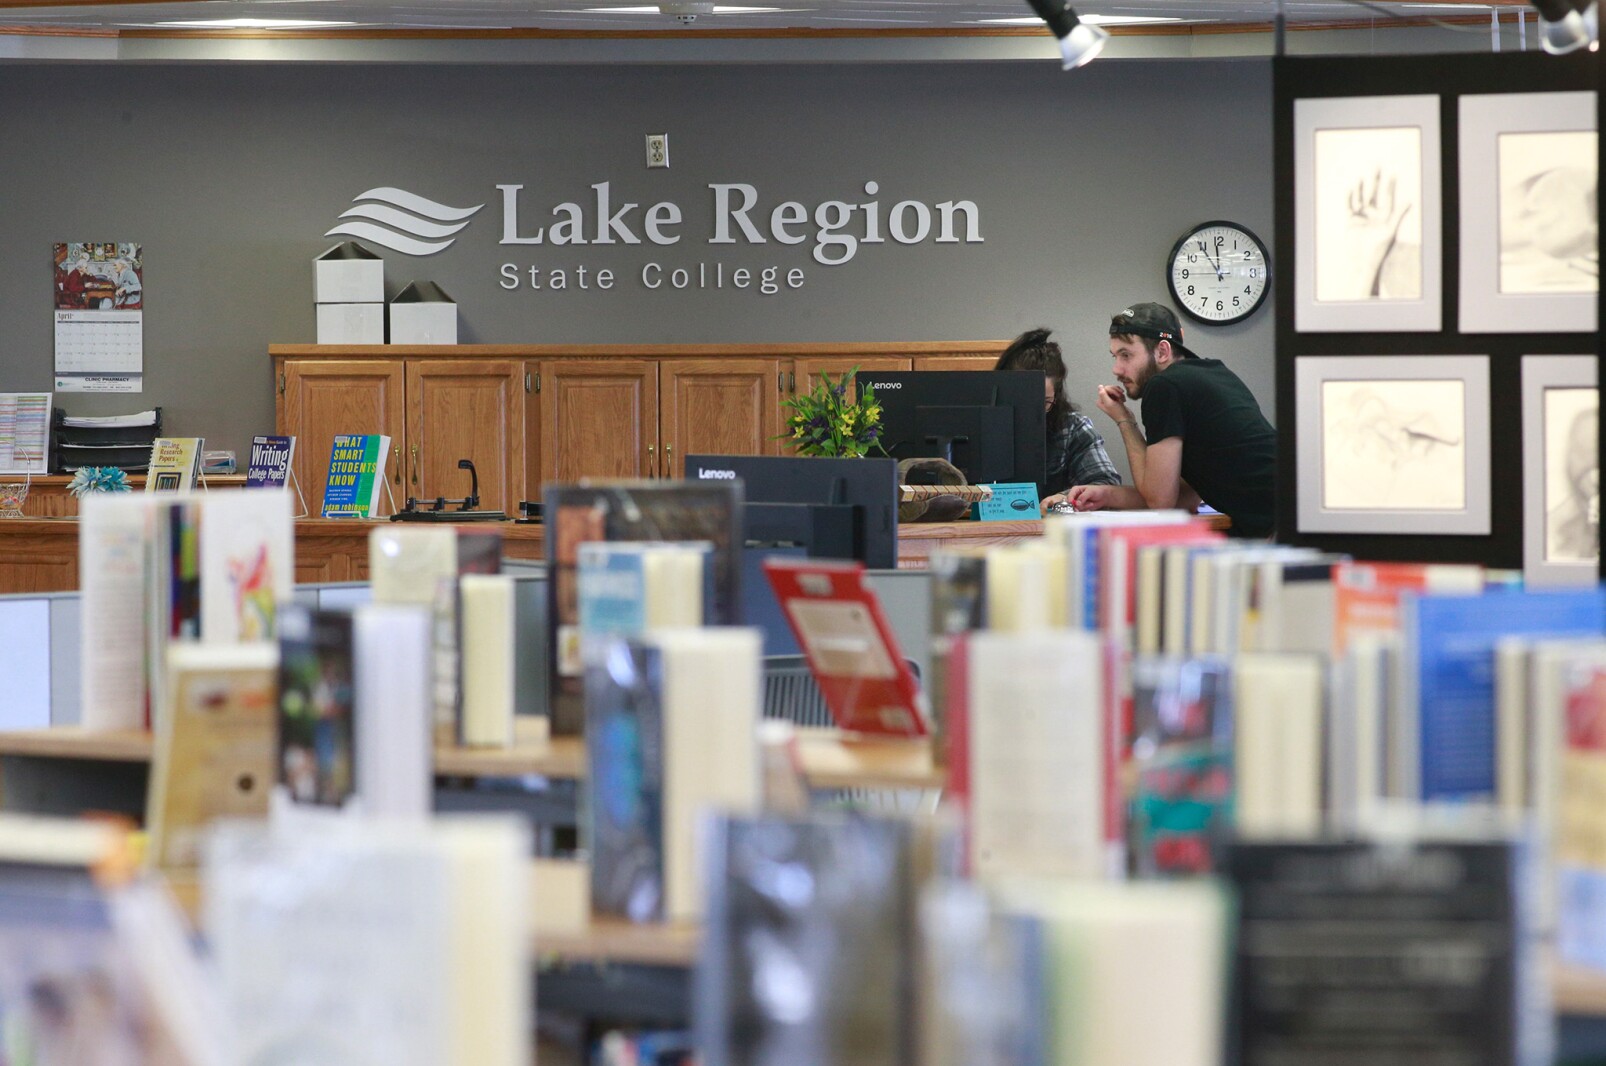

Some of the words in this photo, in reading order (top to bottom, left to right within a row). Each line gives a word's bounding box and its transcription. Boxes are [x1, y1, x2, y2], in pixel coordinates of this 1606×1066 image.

[496, 181, 683, 246] Lake
[708, 181, 985, 265] Region
[1214, 236, 1225, 247] 12
[1233, 240, 1238, 250] 1
[1187, 254, 1198, 263] 10
[1243, 250, 1251, 261] 2
[500, 264, 614, 289] State
[642, 263, 805, 294] College
[1182, 269, 1189, 280] 9
[1249, 268, 1257, 278] 3
[1187, 285, 1195, 296] 8
[1244, 285, 1251, 295] 4
[1201, 297, 1208, 307] 7
[1216, 300, 1224, 311] 6
[1232, 296, 1240, 307] 5
[870, 381, 902, 390] enovo
[252, 444, 289, 471] Writing
[333, 449, 364, 461] SMART
[331, 462, 377, 473] STUDENTS
[248, 467, 267, 482] College
[268, 467, 285, 482] Papers
[699, 468, 736, 480] Lenovo
[329, 475, 356, 486] KNOW
